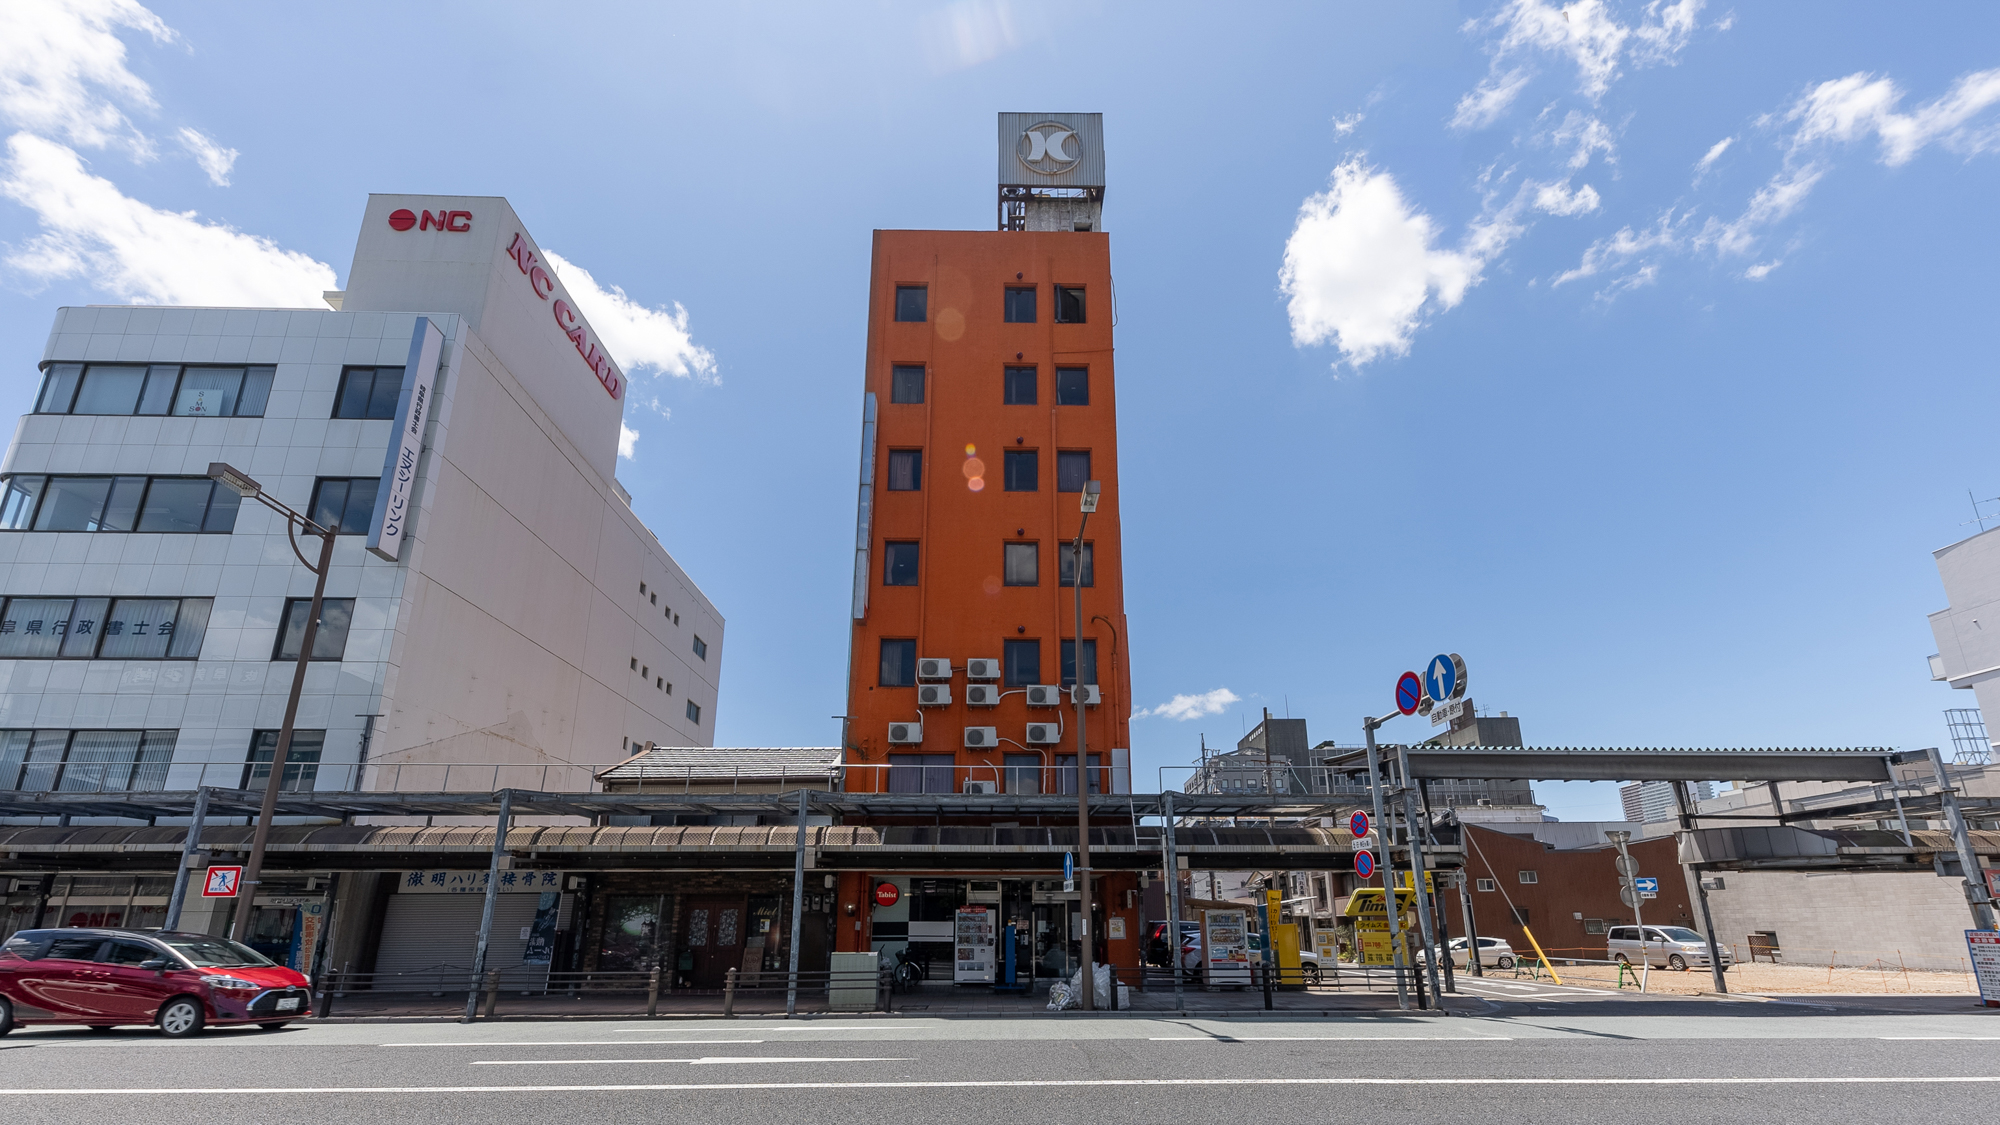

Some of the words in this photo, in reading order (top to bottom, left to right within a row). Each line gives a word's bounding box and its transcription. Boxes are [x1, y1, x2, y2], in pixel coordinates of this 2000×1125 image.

[419, 209, 472, 232] NC
[506, 232, 554, 301] NC
[553, 299, 622, 400] CARD
[386, 447, 415, 536] エヌシーリンク
[1358, 899, 1404, 913] Tims
